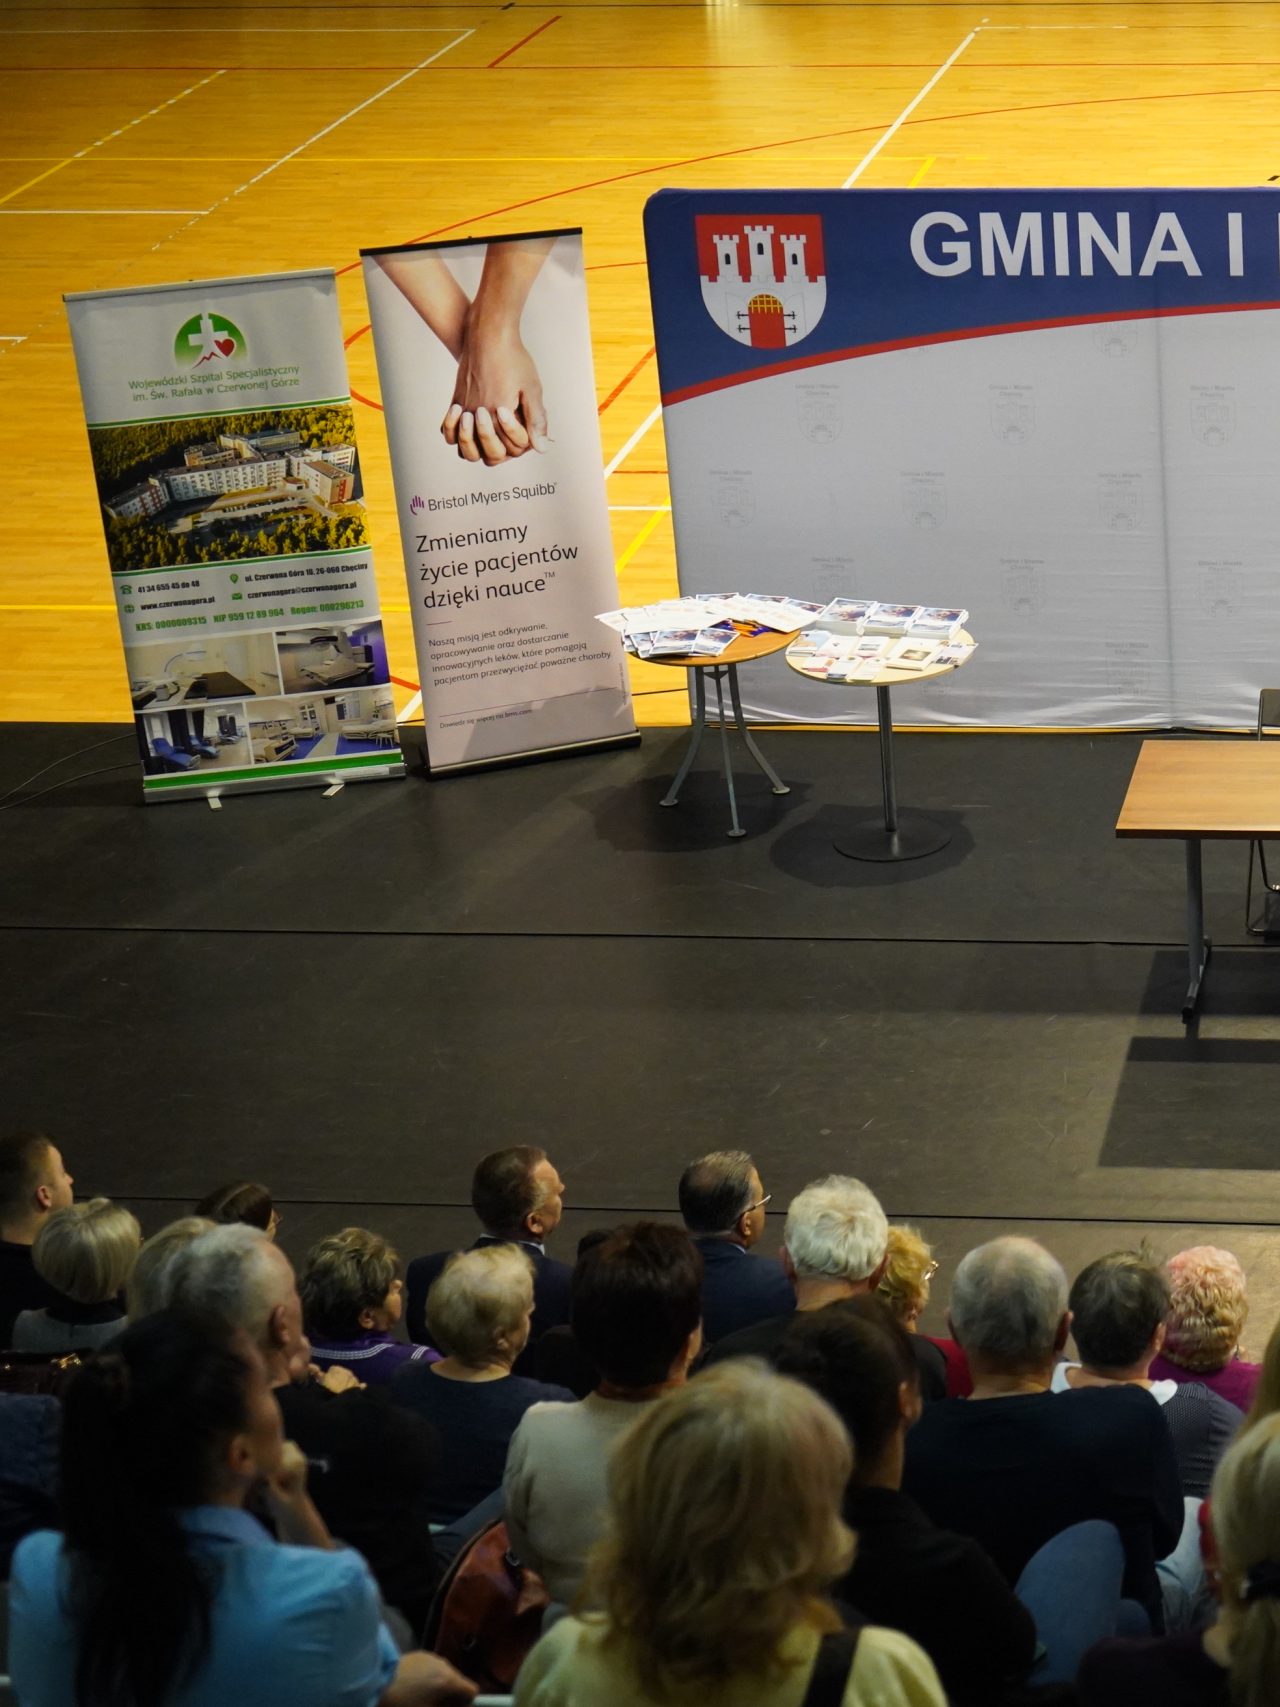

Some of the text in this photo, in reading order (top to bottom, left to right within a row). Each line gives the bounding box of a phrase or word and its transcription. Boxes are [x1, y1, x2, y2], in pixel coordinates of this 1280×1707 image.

[909, 211, 1203, 278] GMINA
[1227, 211, 1244, 277] I
[128, 366, 300, 390] Wojewódzki Szpital Specjalistyczny
[133, 377, 299, 401] im. Św. Rafała w Czerwonej Górze
[428, 494, 468, 511] Bristol
[471, 490, 510, 505] Myers
[415, 524, 528, 553] Zmieniamy
[420, 544, 579, 585] życie pacjentów
[423, 585, 480, 609] dzięki
[428, 638, 456, 647] Naszą
[457, 632, 480, 642] misją
[481, 630, 496, 640] jest
[430, 632, 569, 661] opracowywanie oraz dostarczanie
[432, 656, 493, 672] innowacyjnych
[521, 649, 543, 658] które
[544, 641, 587, 656] pomagają
[434, 671, 479, 687] pacjentom
[540, 656, 577, 670] poważne
[578, 651, 611, 663] choroby
